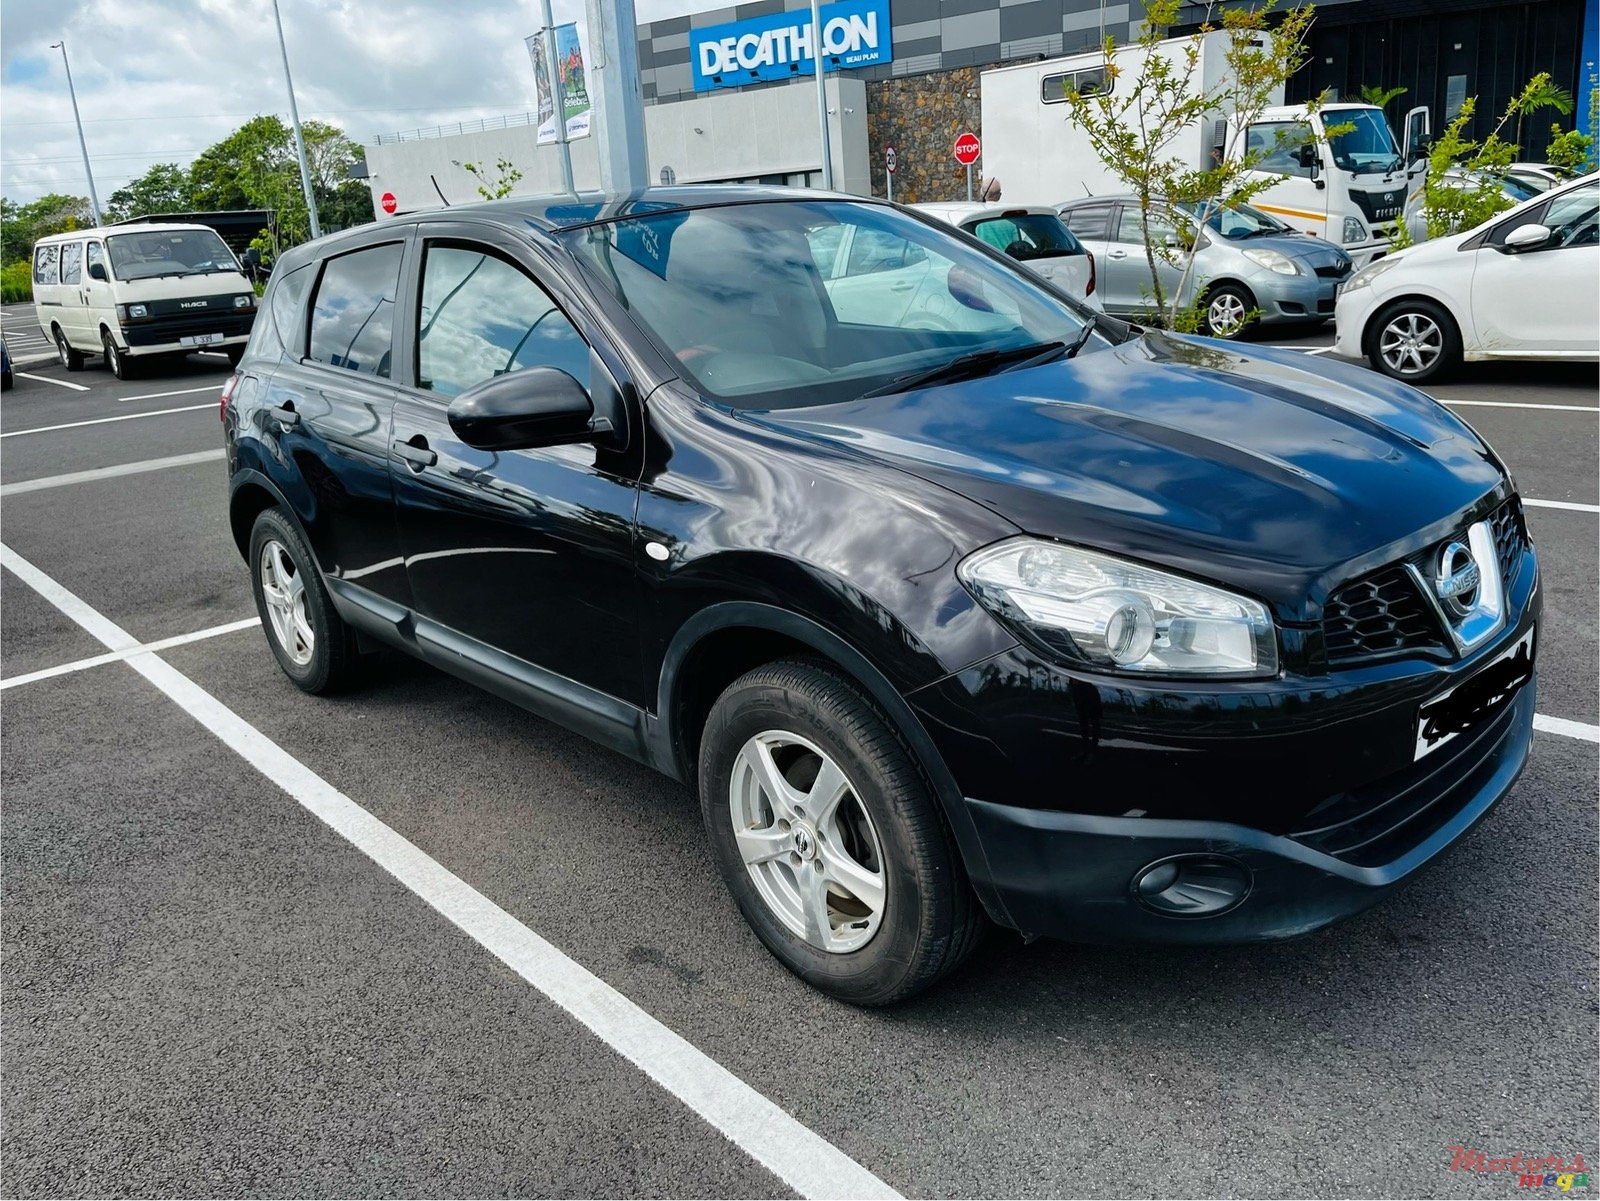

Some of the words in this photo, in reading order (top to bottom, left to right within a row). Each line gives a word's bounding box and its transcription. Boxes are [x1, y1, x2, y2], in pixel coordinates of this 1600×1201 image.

[846, 55, 862, 64] BEAU
[862, 52, 879, 61] PLAN
[956, 143, 978, 155] STOP
[887, 153, 895, 165] 20
[382, 199, 396, 207] STOP
[1452, 571, 1479, 592] NISS
